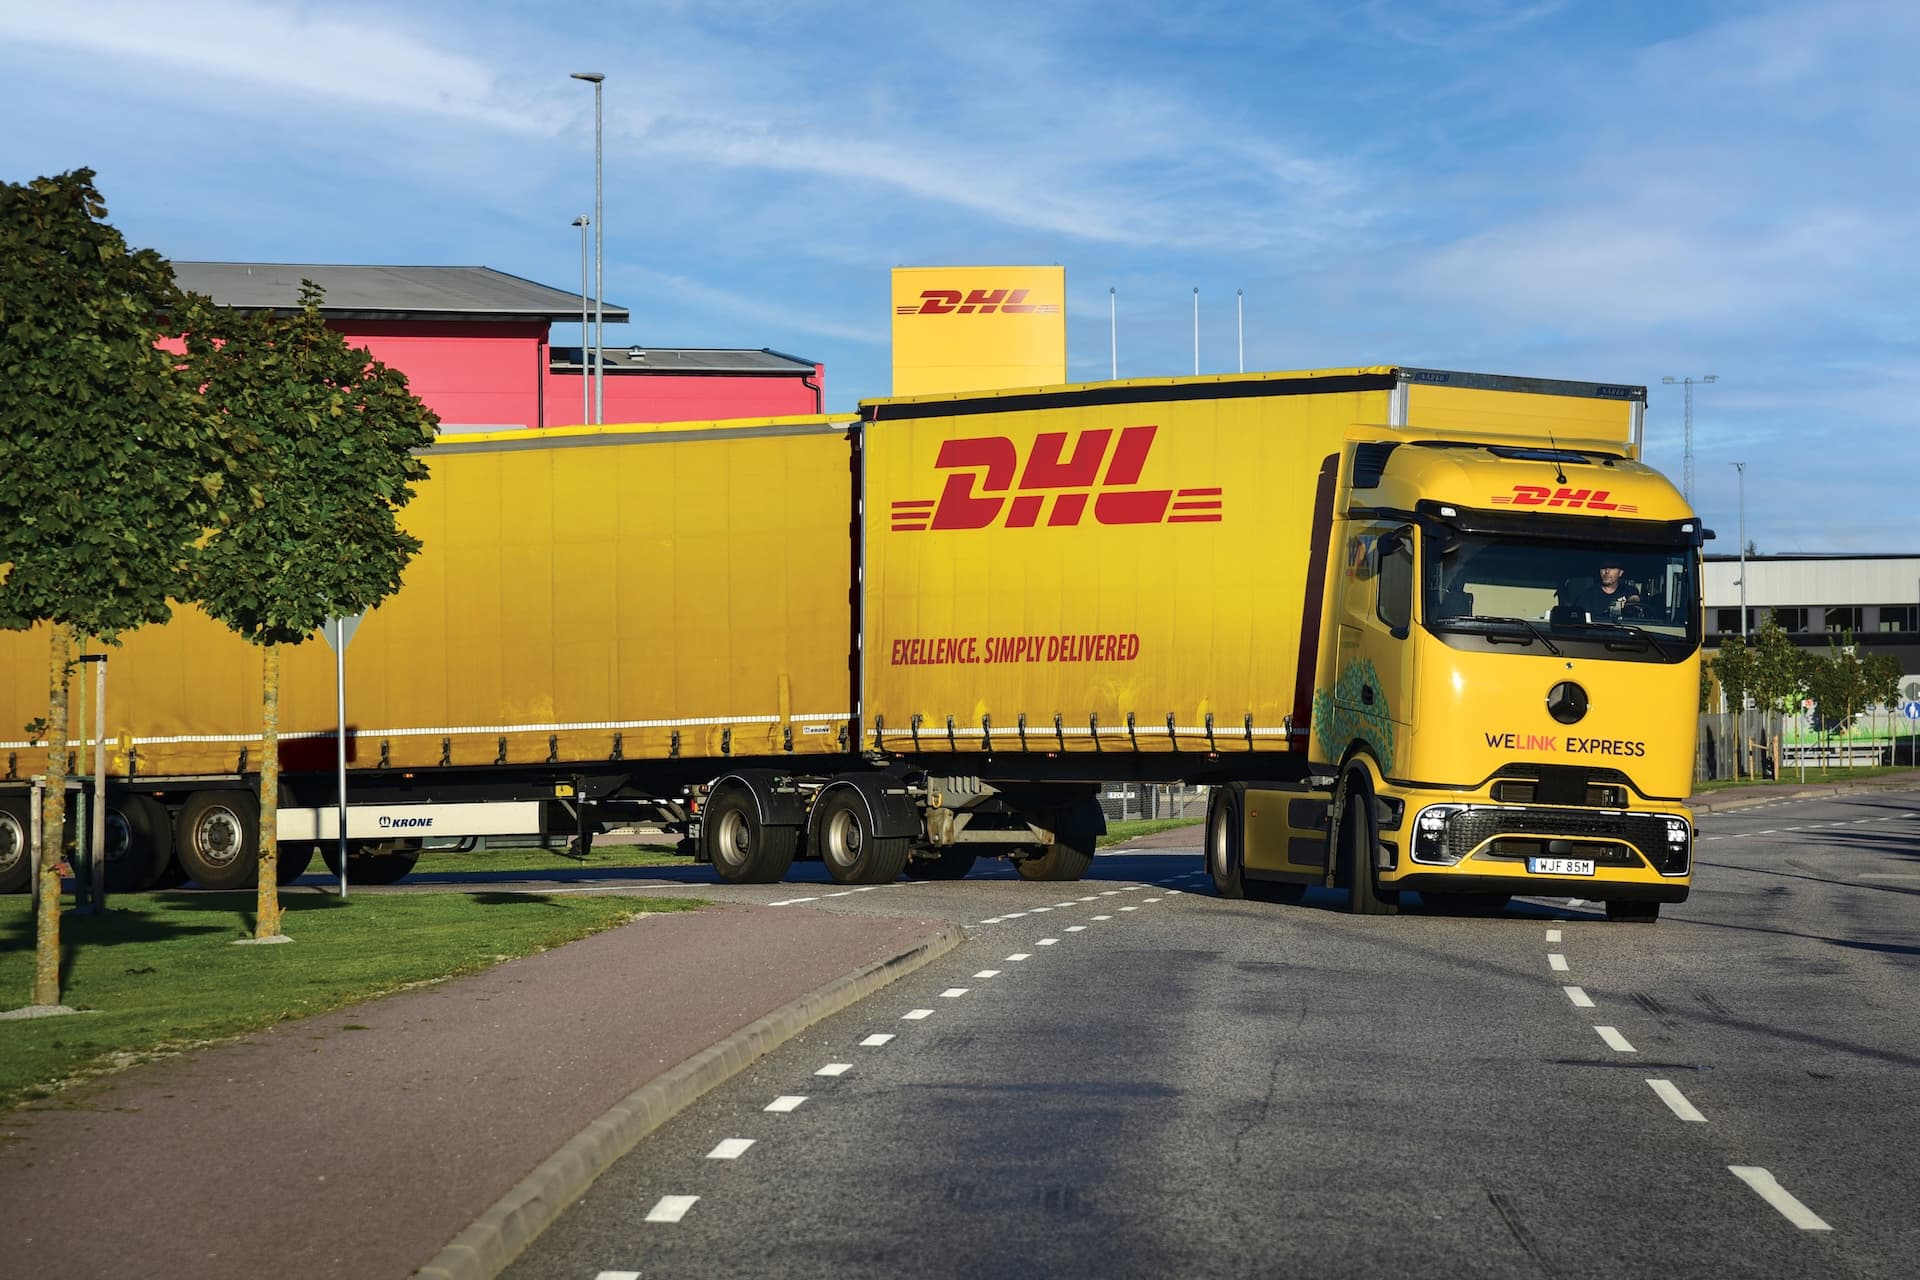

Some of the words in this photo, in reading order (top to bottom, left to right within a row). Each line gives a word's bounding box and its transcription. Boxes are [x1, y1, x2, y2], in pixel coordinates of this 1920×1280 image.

[918, 289, 1036, 314] DHL
[930, 425, 1174, 531] DHL
[1512, 485, 1618, 511] DHL
[891, 637, 980, 665] EXELLENCE.
[983, 635, 1046, 664] SIMPLY
[1047, 633, 1140, 663] DELIVERED
[1566, 737, 1646, 757] EXPRESS
[392, 817, 434, 828] KRONE
[1540, 860, 1563, 872] WJF
[1566, 861, 1589, 873] 85M
